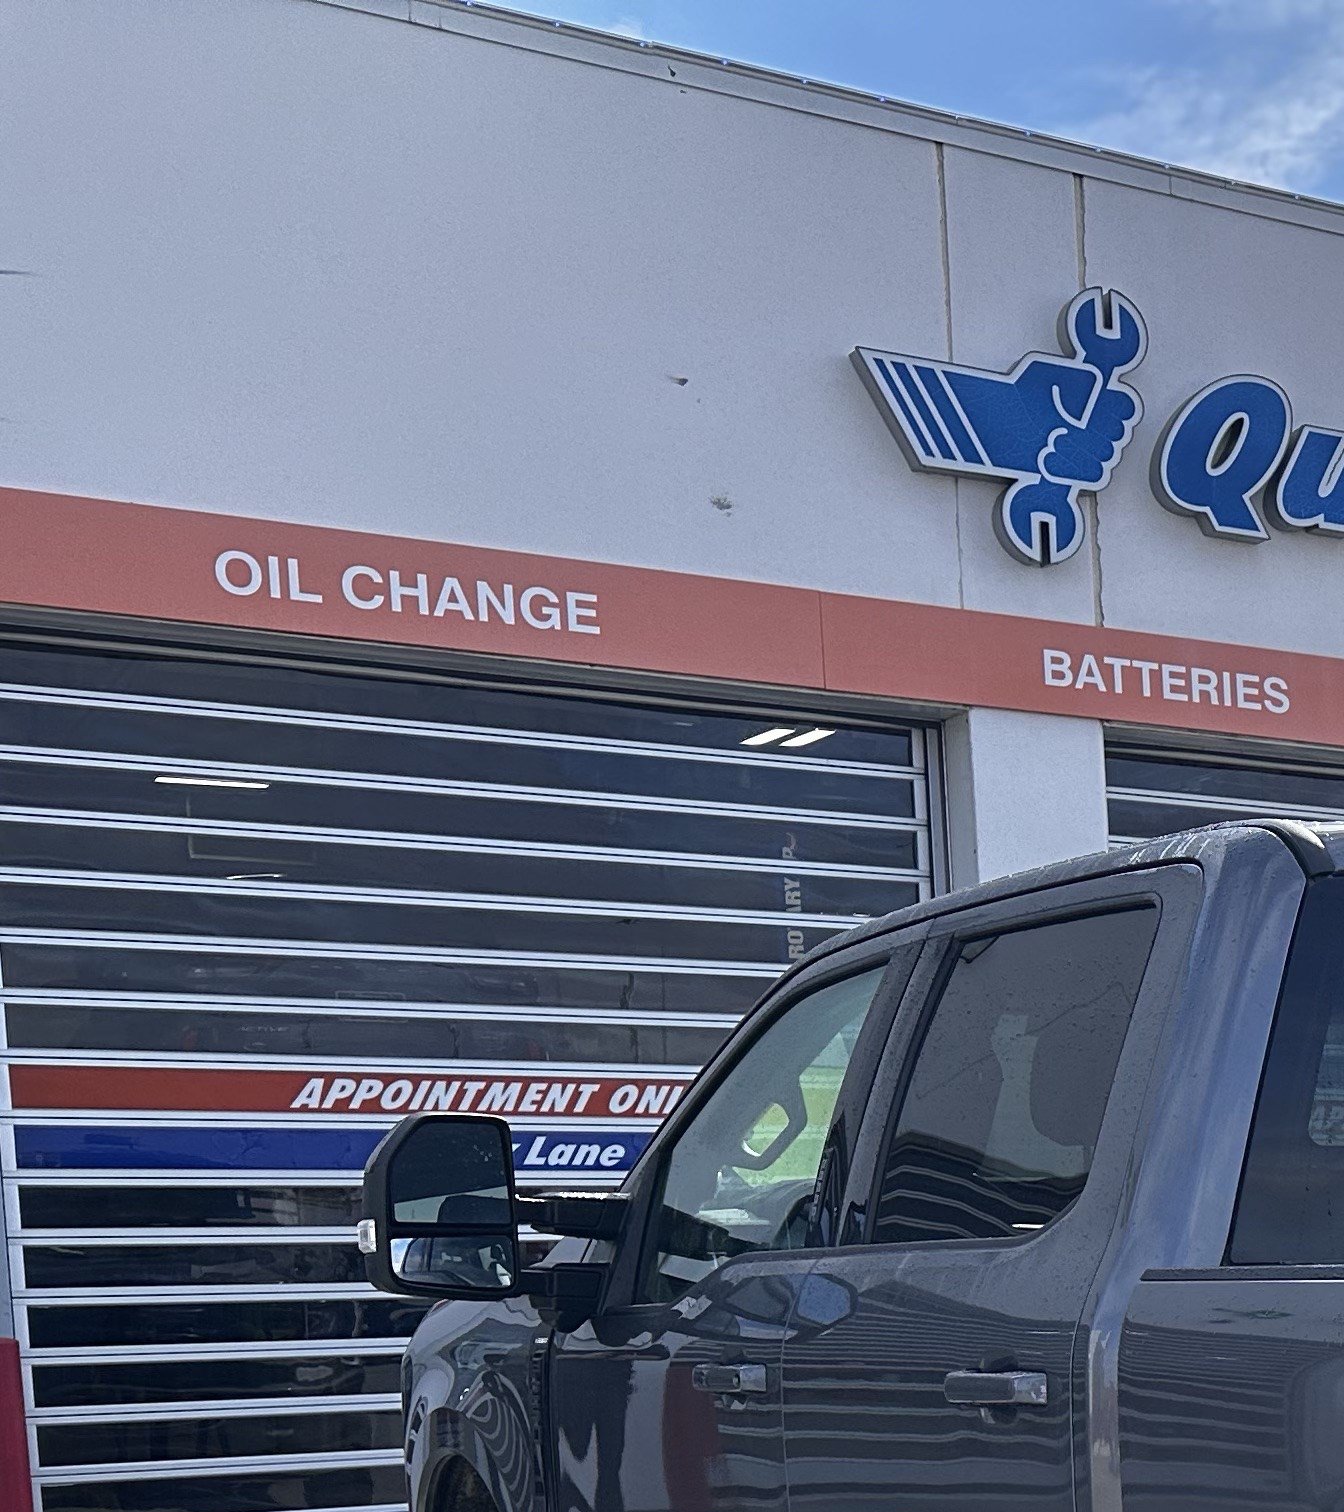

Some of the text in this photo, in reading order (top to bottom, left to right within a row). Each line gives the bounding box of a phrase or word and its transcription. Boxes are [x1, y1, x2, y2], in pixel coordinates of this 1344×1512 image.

[214, 550, 601, 635] OIL CHANGE
[1043, 649, 1290, 714] BATTERIES
[290, 1077, 601, 1113] APPOINTMENT
[523, 1136, 626, 1167] Lane
